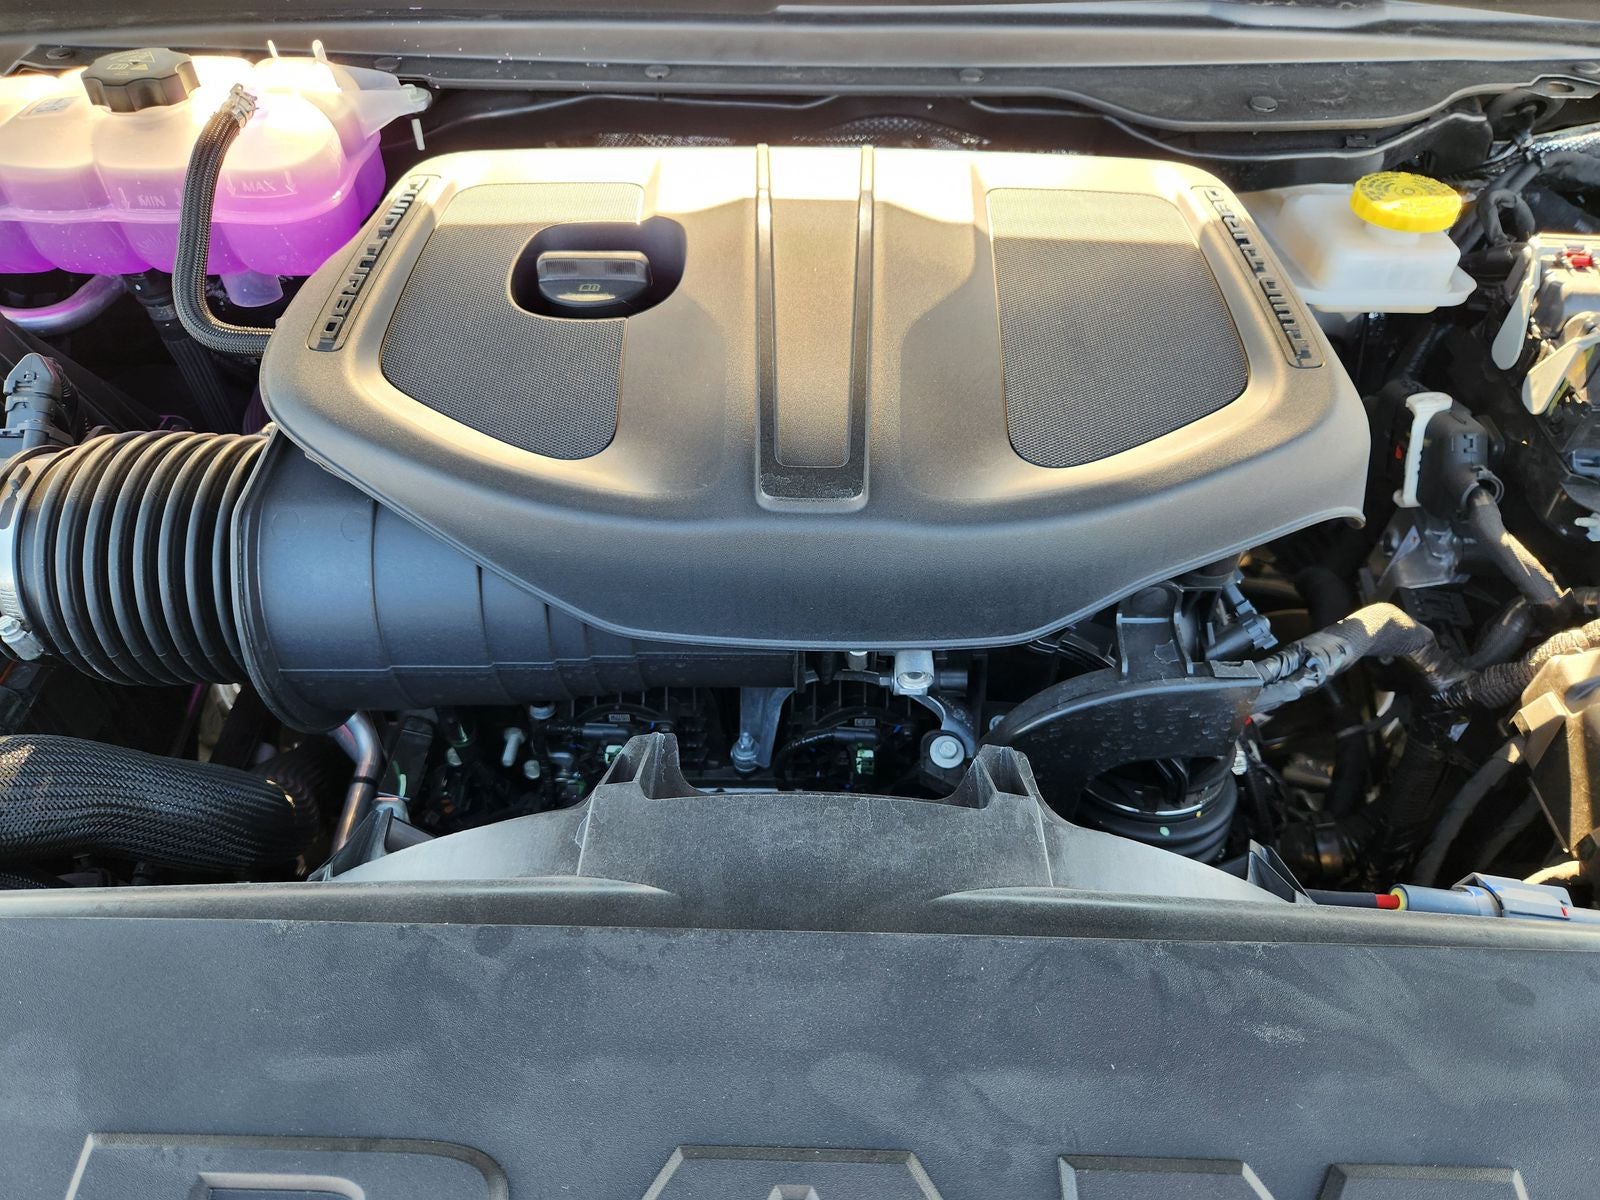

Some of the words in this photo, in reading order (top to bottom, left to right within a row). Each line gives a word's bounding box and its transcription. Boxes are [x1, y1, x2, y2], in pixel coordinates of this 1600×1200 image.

[137, 193, 167, 208] MIN
[242, 180, 277, 193] MAX
[377, 177, 429, 241] TWIN
[319, 236, 388, 344] TURBO
